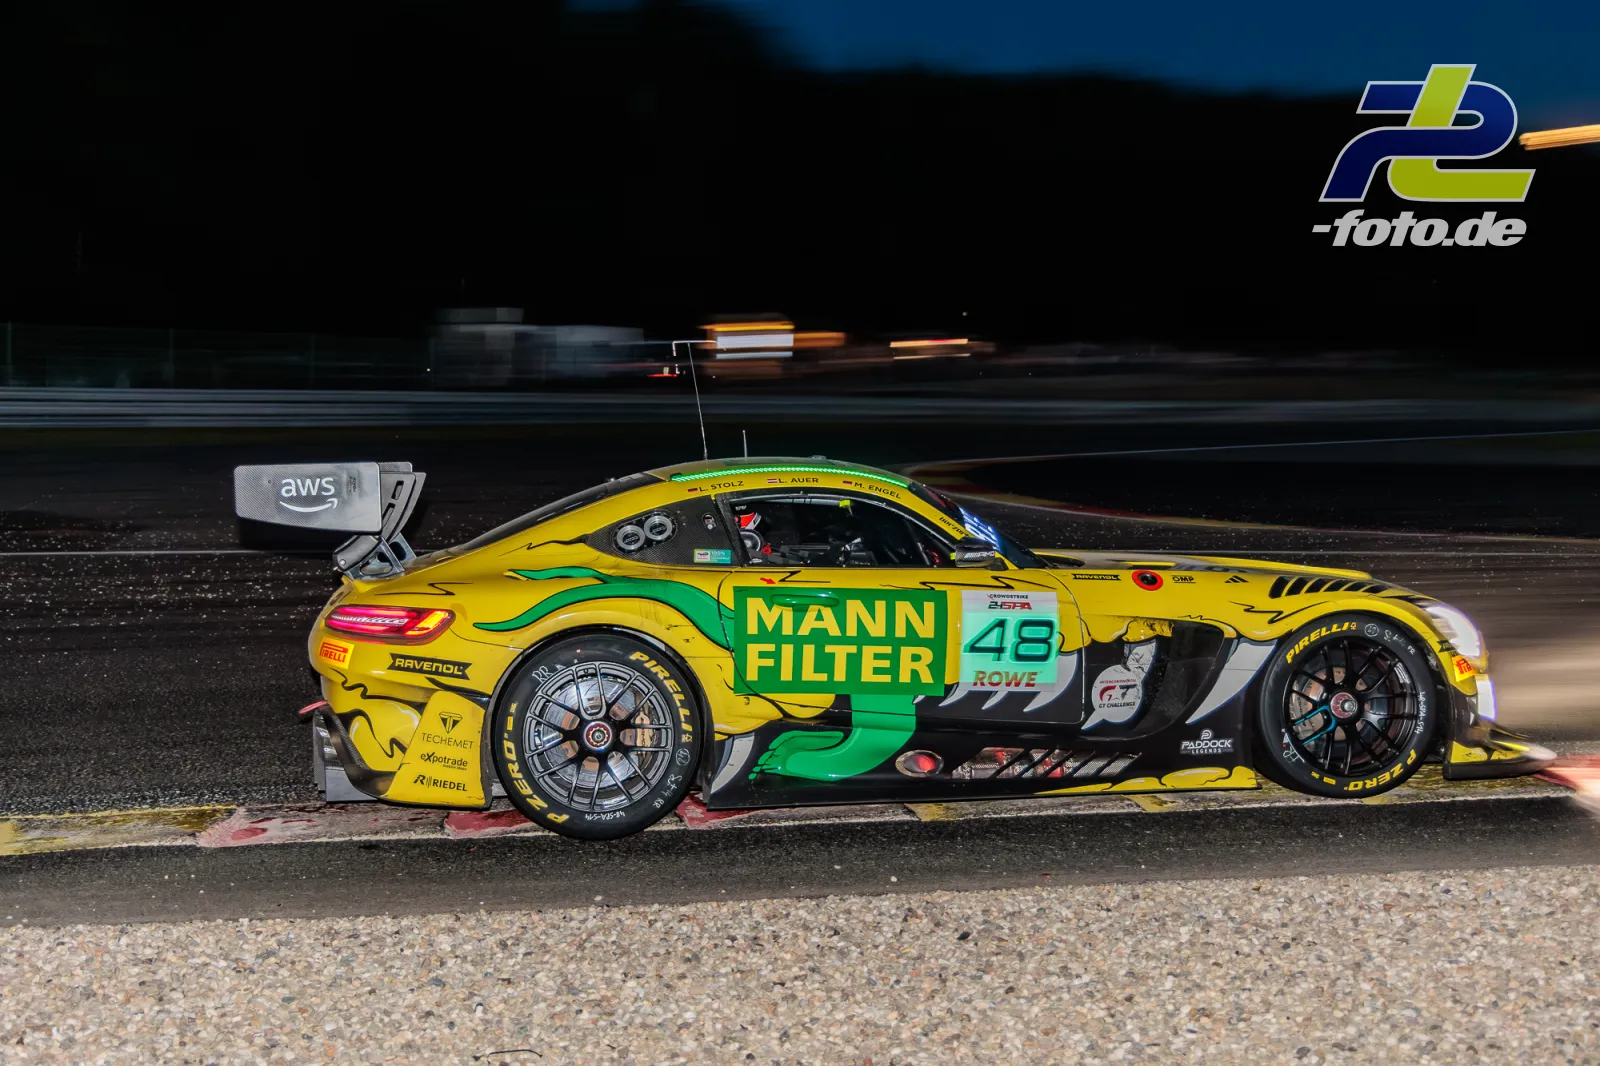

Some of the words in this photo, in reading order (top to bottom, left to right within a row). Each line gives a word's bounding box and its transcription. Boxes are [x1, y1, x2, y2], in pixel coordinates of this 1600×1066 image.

[281, 475, 336, 497] aws
[710, 480, 744, 490] STOLZ
[868, 484, 902, 499] ENGEL
[746, 597, 935, 639] MANN
[962, 617, 1056, 663] 48
[1286, 622, 1349, 664] PIRELLI
[319, 642, 349, 663] PIRELLI
[395, 657, 463, 675] RAVENOL
[746, 643, 935, 684] FILTER
[972, 670, 1039, 688] ROWE
[629, 651, 693, 732] PIRELLI
[1106, 701, 1136, 709] CHALLENGE
[421, 732, 474, 749] TECHEMET
[1181, 739, 1232, 749] PADDOCK
[1406, 749, 1417, 766] P
[504, 739, 548, 811] ZERO
[1349, 765, 1404, 791] ZERO
[432, 778, 468, 792] RIEDEL
[547, 813, 570, 824] P
